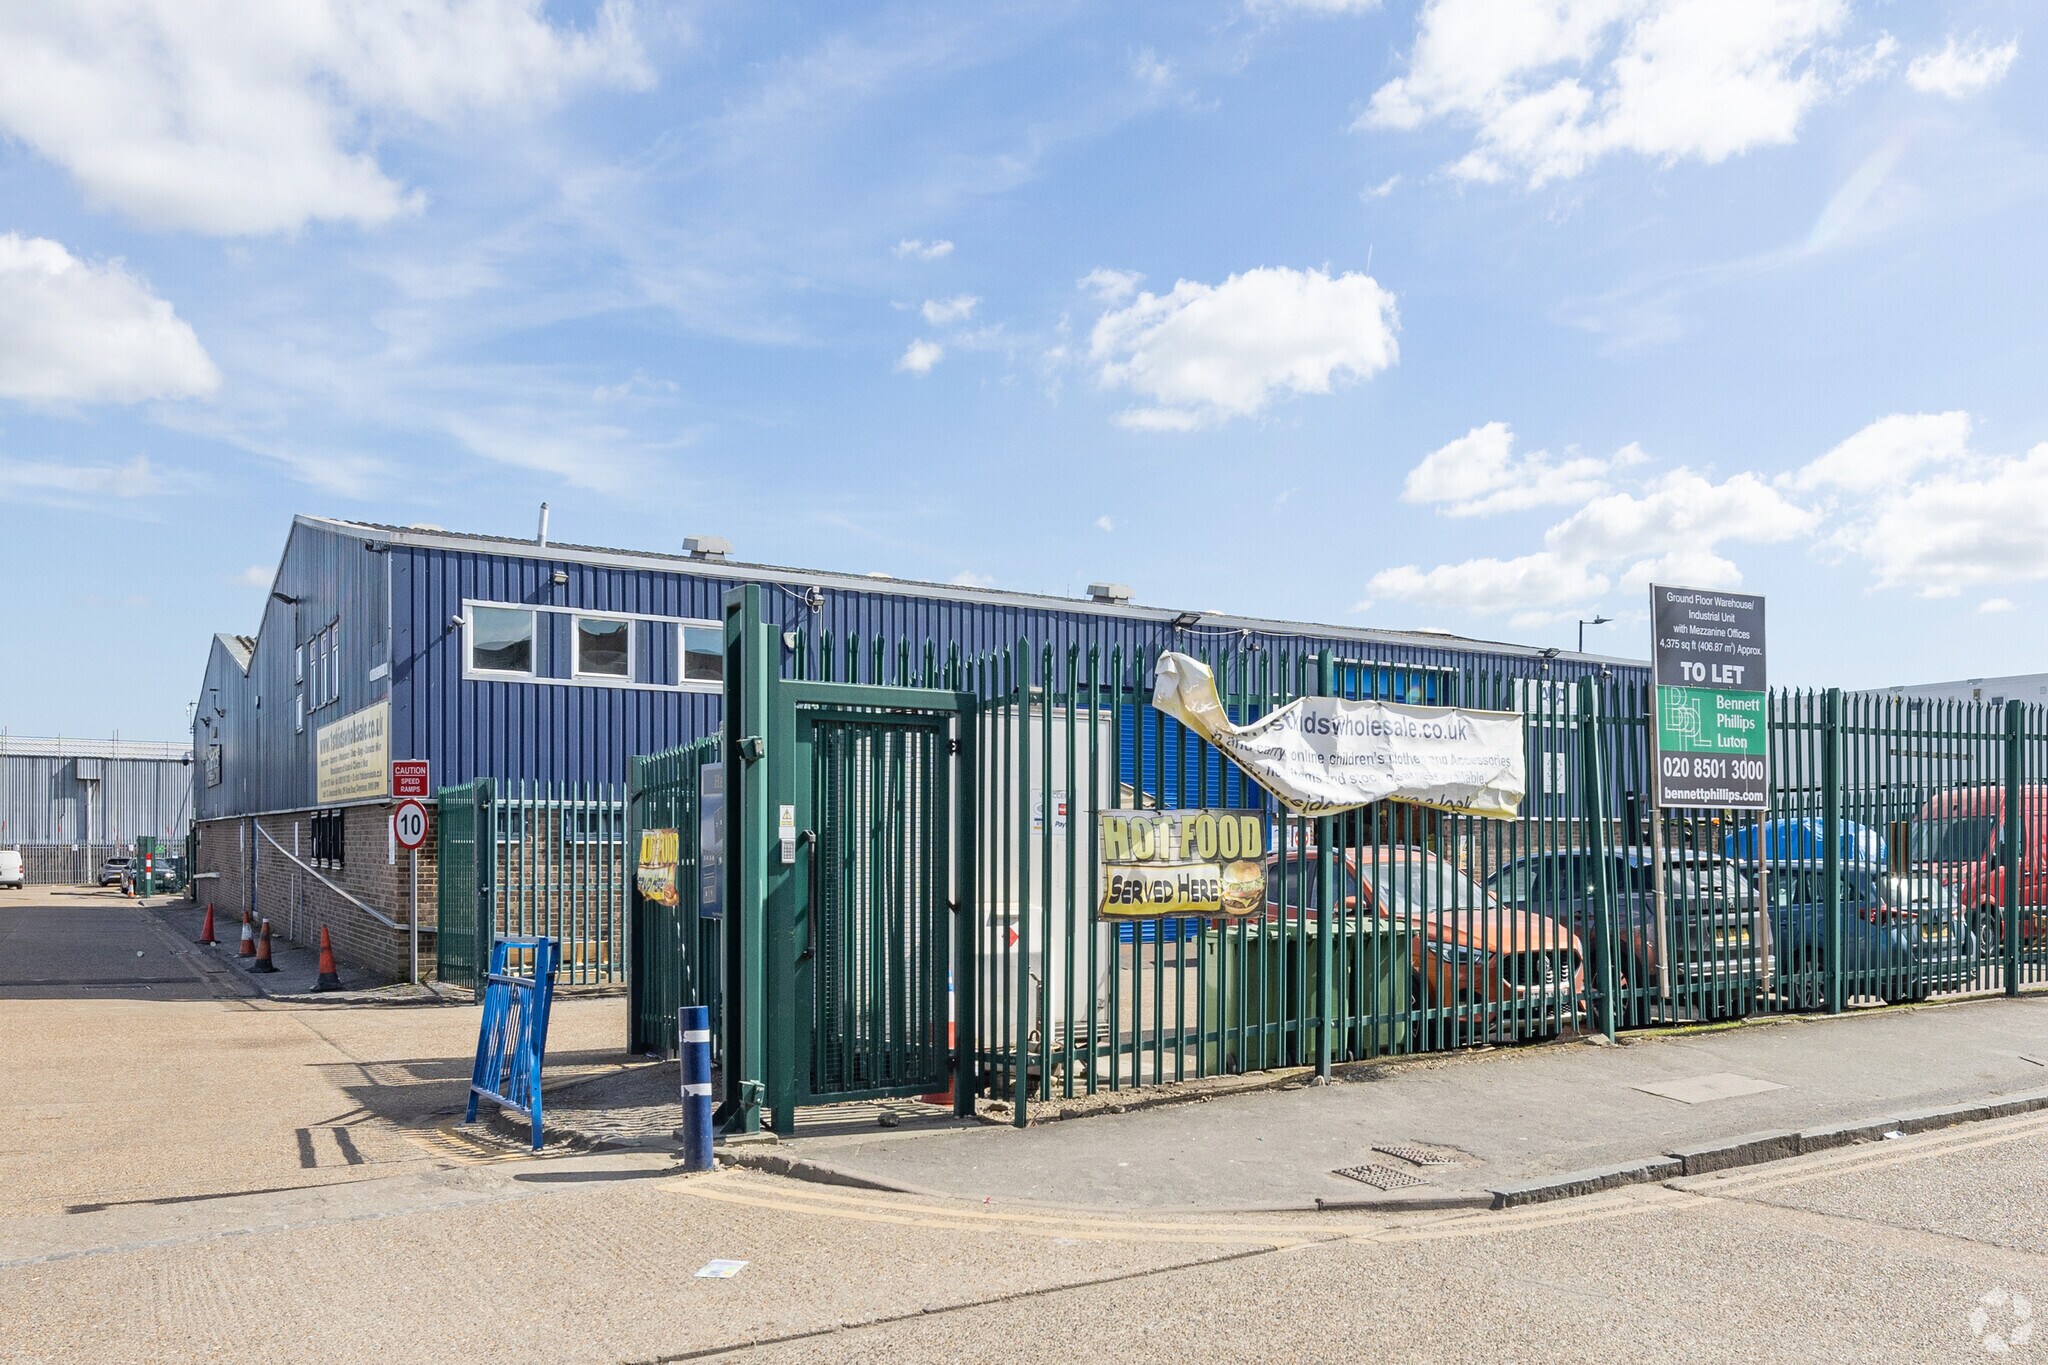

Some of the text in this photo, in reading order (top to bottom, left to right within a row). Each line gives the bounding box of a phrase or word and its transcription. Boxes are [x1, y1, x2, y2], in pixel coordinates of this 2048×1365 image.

[1667, 592, 1755, 611] Ground Floor Warehouse/
[1689, 609, 1735, 623] Industrial Unit
[1673, 624, 1750, 639] with Mezzanine Offices
[1660, 638, 1680, 649] 4,375
[1681, 641, 1690, 651] sq
[1691, 640, 1697, 650] ft
[1698, 642, 1723, 653] (406.87
[1737, 645, 1763, 656] Approx.
[1681, 661, 1745, 684] TO LET
[1716, 694, 1760, 711] Bennett
[1716, 713, 1755, 733] Phillips
[1717, 733, 1748, 749] Luton
[1291, 749, 1325, 764] online
[1329, 751, 1385, 766] children's
[395, 766, 426, 775] CAUTION
[1663, 757, 1764, 780] 020 8501 3000
[1664, 787, 1763, 803] bennettphillips.com
[400, 814, 421, 835] 10
[1102, 814, 1262, 860] HOT FOOD
[1108, 873, 1219, 904] SERVED HERE
